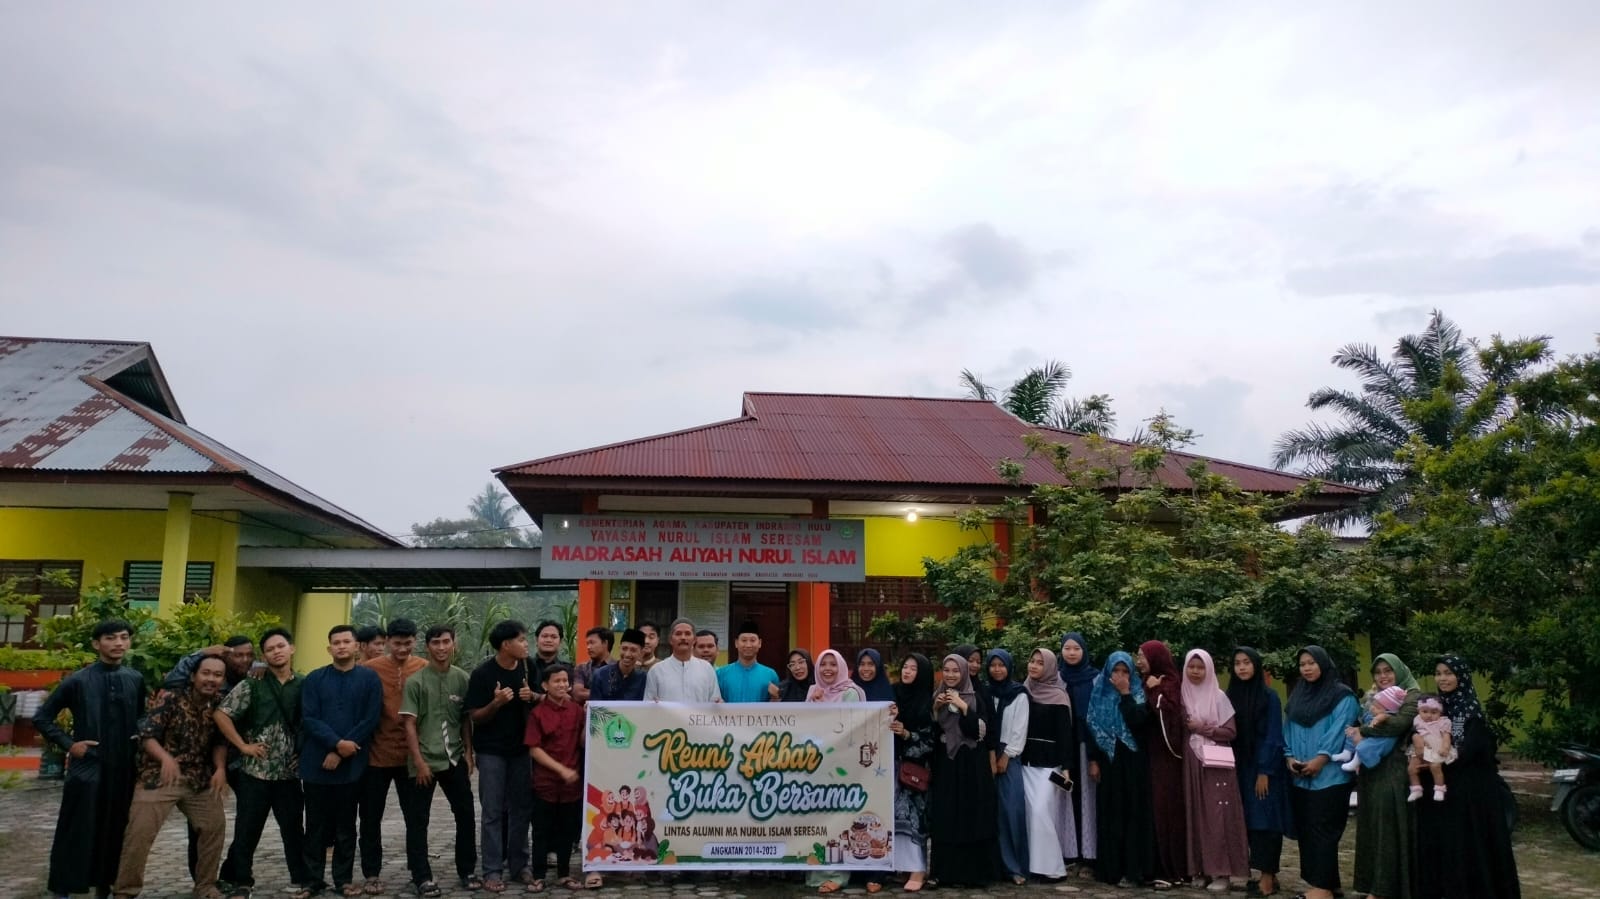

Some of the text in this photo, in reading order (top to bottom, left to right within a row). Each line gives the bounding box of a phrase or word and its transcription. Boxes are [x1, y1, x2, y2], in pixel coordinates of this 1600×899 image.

[591, 530, 822, 546] YAYASAN NURUL ISLAM SERESAM
[551, 545, 856, 564] MADRASAH ALIYAH NURUL ISLAM
[688, 715, 796, 727] SELAMAT DATANG
[643, 728, 823, 779] Reuni Akbar
[666, 770, 868, 820] Buka Bersama
[664, 826, 828, 837] LINTAS ALUMNI MA NURUL ISLAM SERESAM
[710, 846, 777, 856] ANGKATAN 2014-2023
